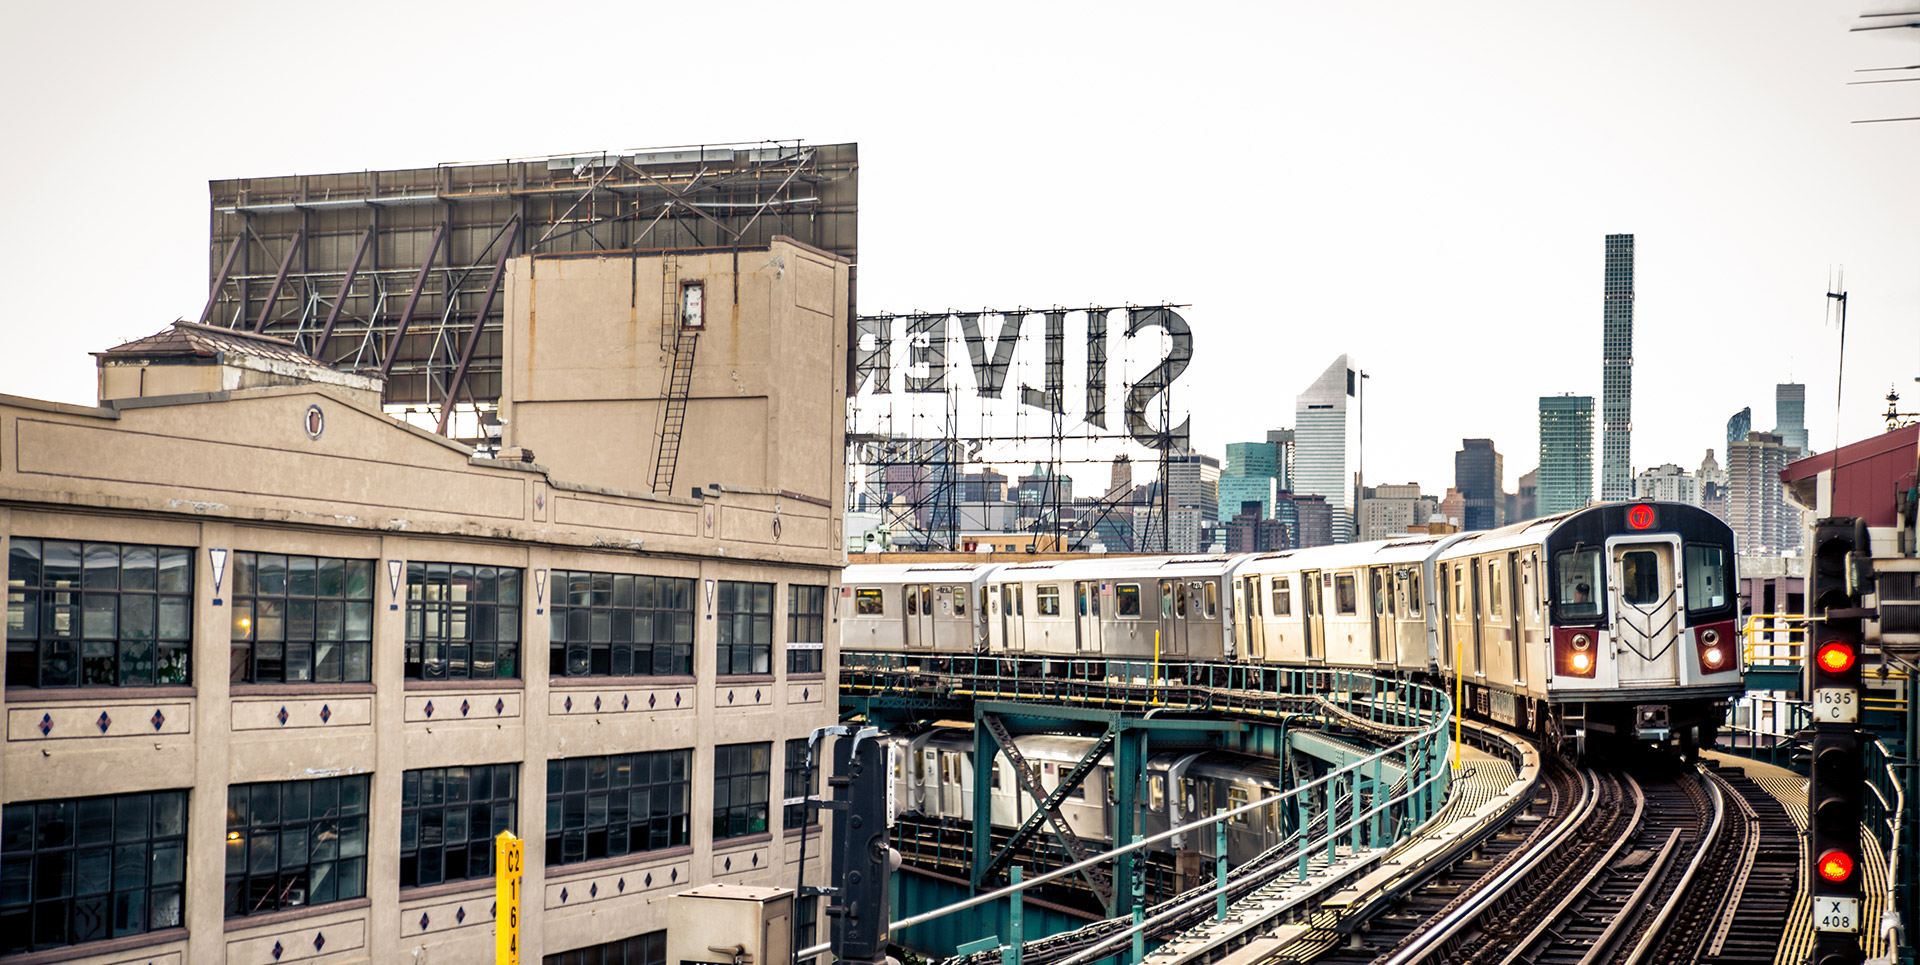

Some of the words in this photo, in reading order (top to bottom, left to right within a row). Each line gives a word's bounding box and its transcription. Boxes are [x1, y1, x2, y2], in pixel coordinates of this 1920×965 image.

[1820, 692, 1851, 704] 1635
[1831, 707, 1839, 718] C
[508, 850, 520, 872] C2
[1831, 902, 1841, 913] X
[1823, 916, 1850, 928] 408
